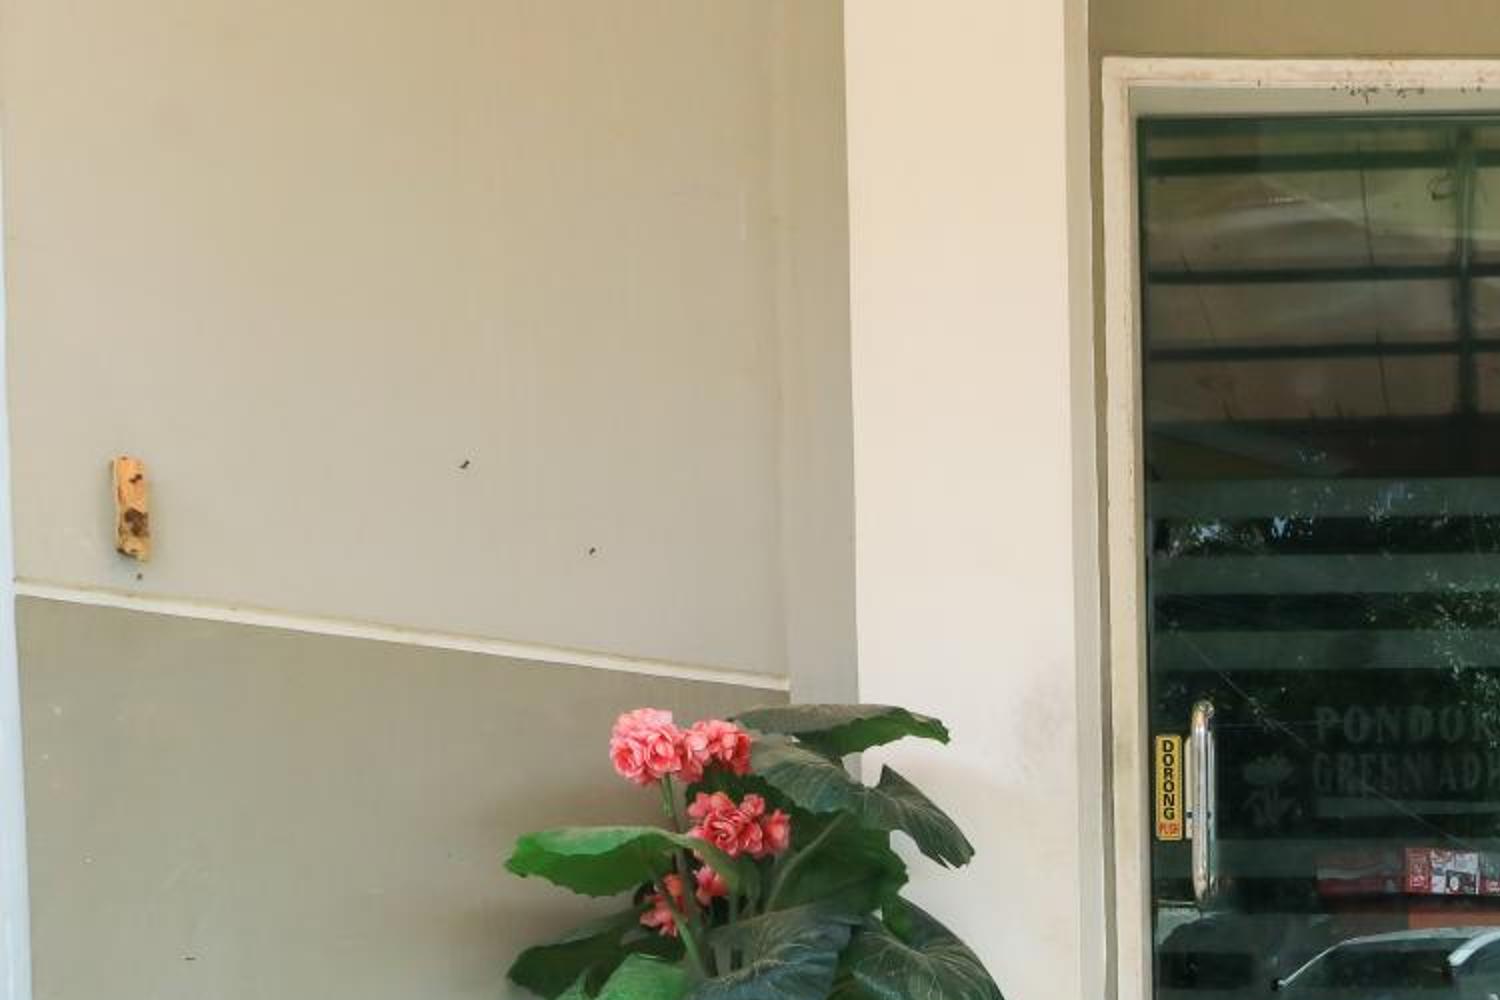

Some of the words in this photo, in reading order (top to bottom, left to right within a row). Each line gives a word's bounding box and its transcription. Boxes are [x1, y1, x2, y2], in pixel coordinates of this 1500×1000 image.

[1314, 704, 1497, 743] PONDOK
[1162, 739, 1175, 820] DORONG
[1311, 751, 1430, 794] GREEN
